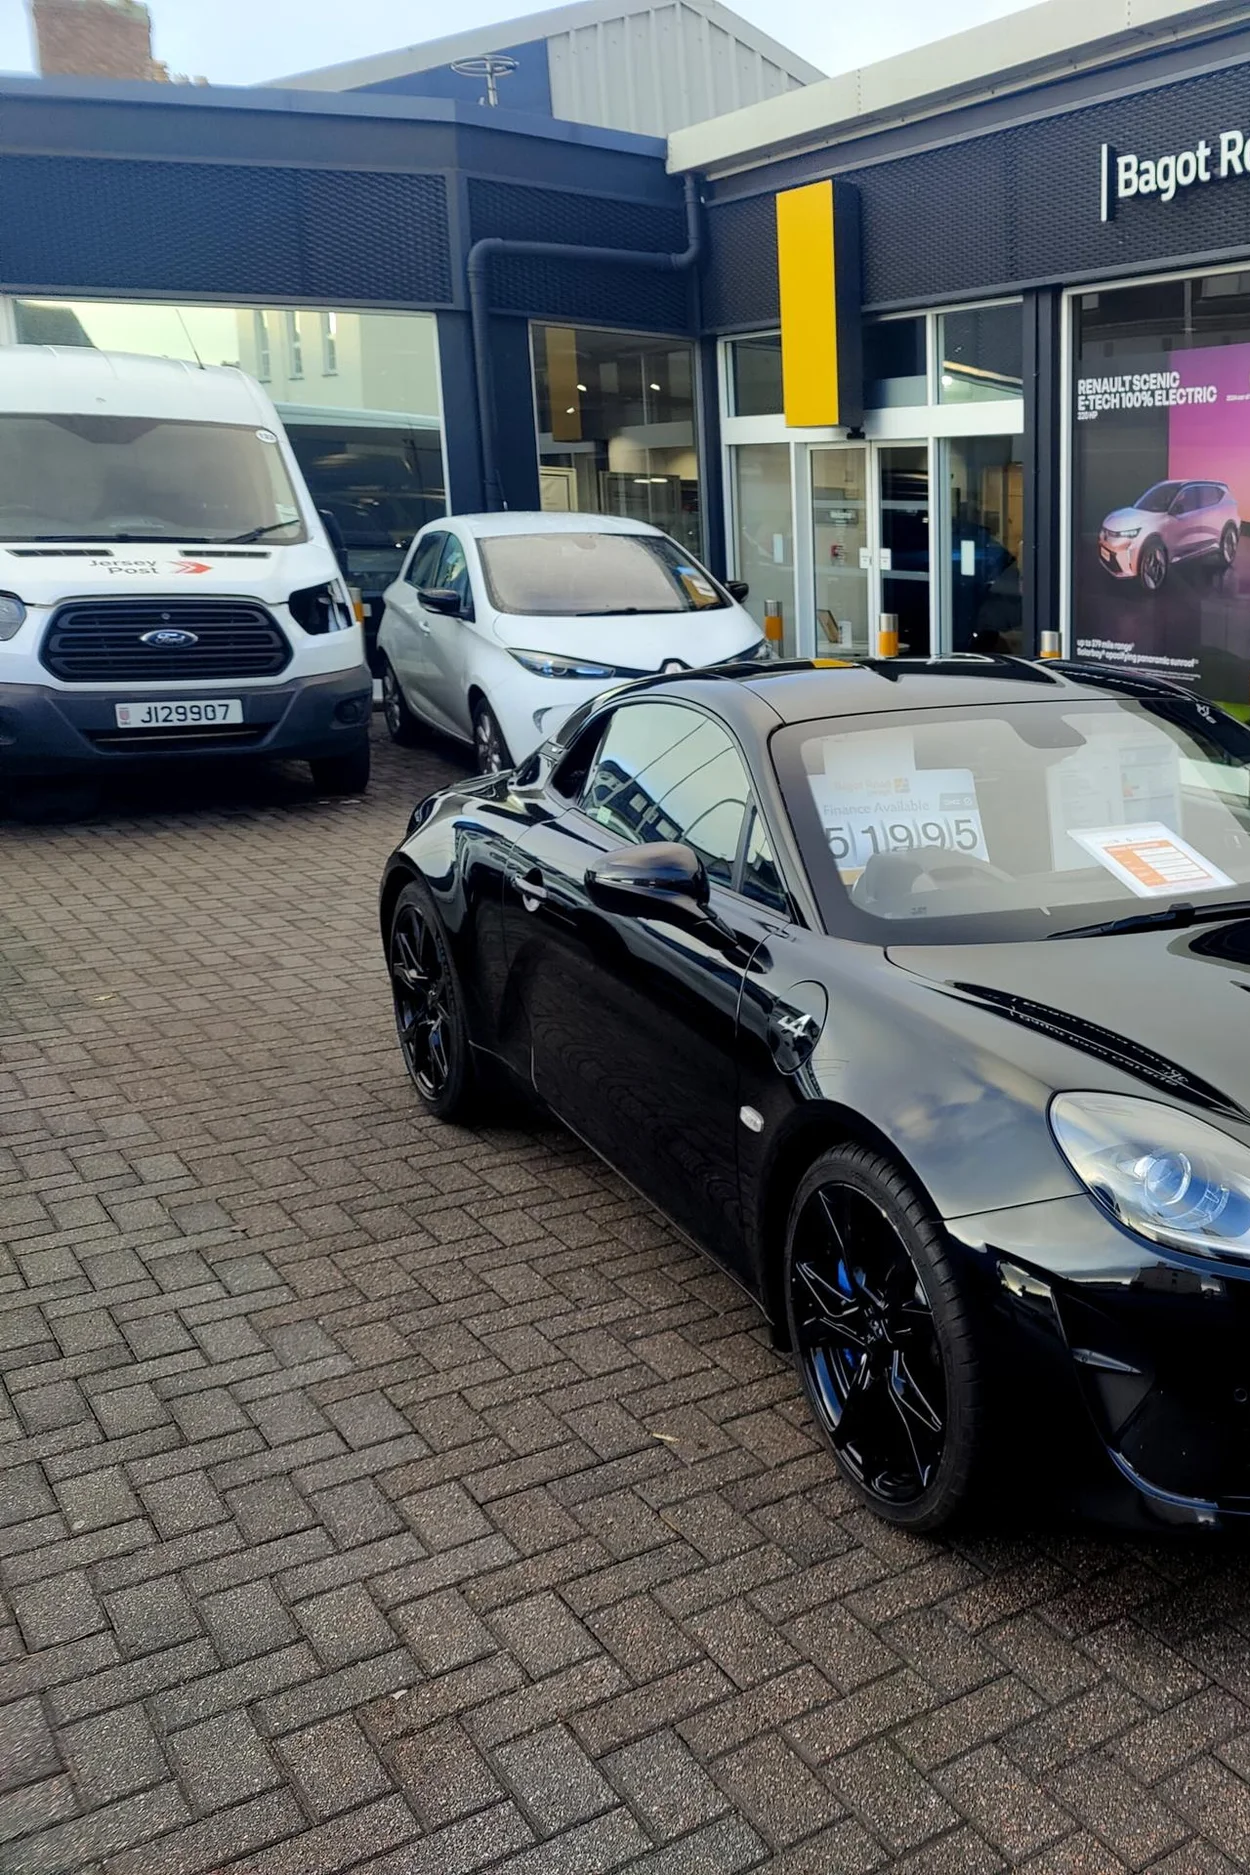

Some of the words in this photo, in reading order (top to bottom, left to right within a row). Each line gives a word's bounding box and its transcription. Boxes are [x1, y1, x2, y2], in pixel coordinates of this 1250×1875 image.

[1116, 141, 1211, 201] Bagot
[1078, 376, 1132, 395] RENAULT
[1133, 371, 1181, 391] SCENIC
[1078, 394, 1120, 411] E-TECH
[1121, 389, 1154, 409] 100%
[1154, 385, 1218, 406] ELECTRIC
[89, 559, 157, 569] Jersey
[108, 566, 160, 575] Post
[823, 804, 872, 817] Finance
[874, 799, 930, 813] Available
[825, 818, 979, 860] 51995
